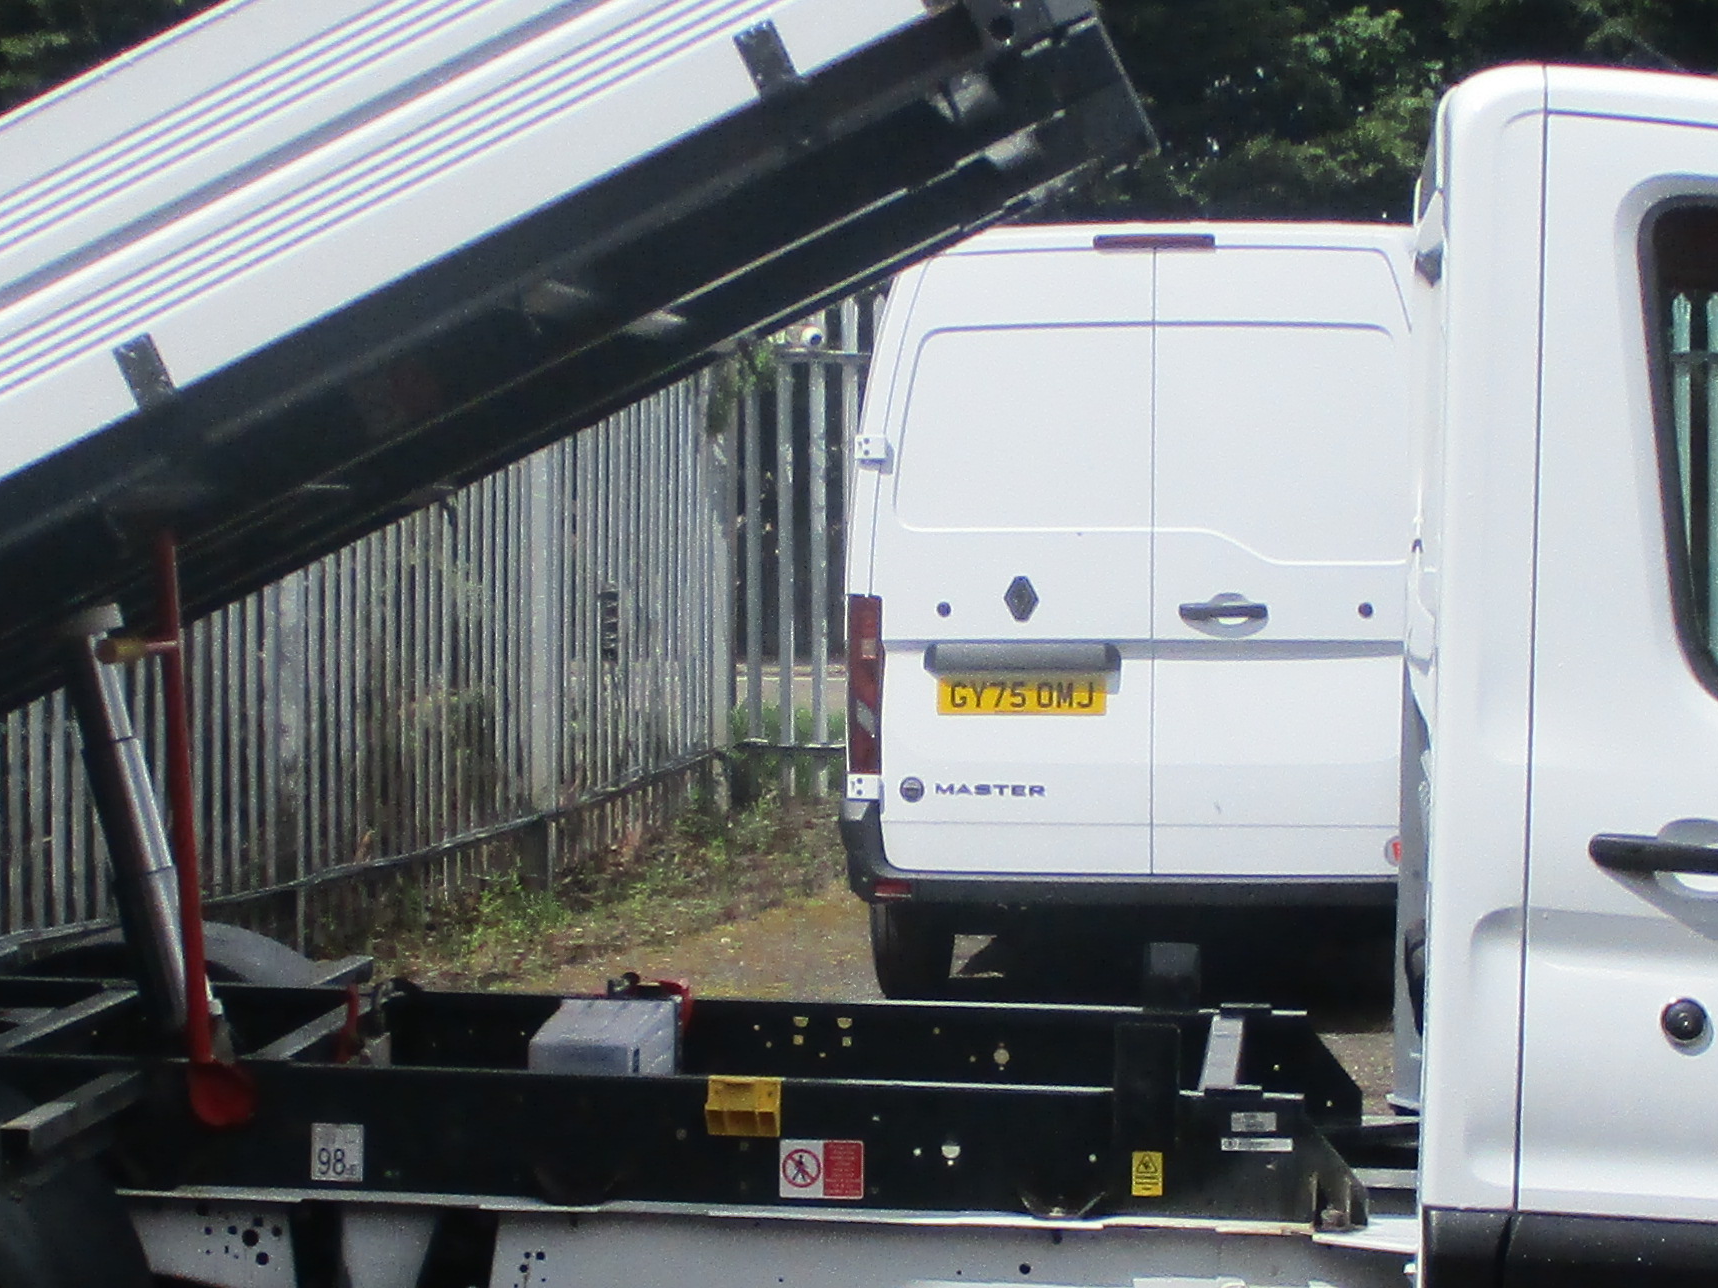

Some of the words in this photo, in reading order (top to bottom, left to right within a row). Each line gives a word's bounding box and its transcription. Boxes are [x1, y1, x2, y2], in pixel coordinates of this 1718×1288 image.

[951, 681, 1027, 709] GY75
[1036, 681, 1094, 709] OMJ
[934, 783, 1046, 798] MASTER
[318, 1147, 346, 1175] 98
